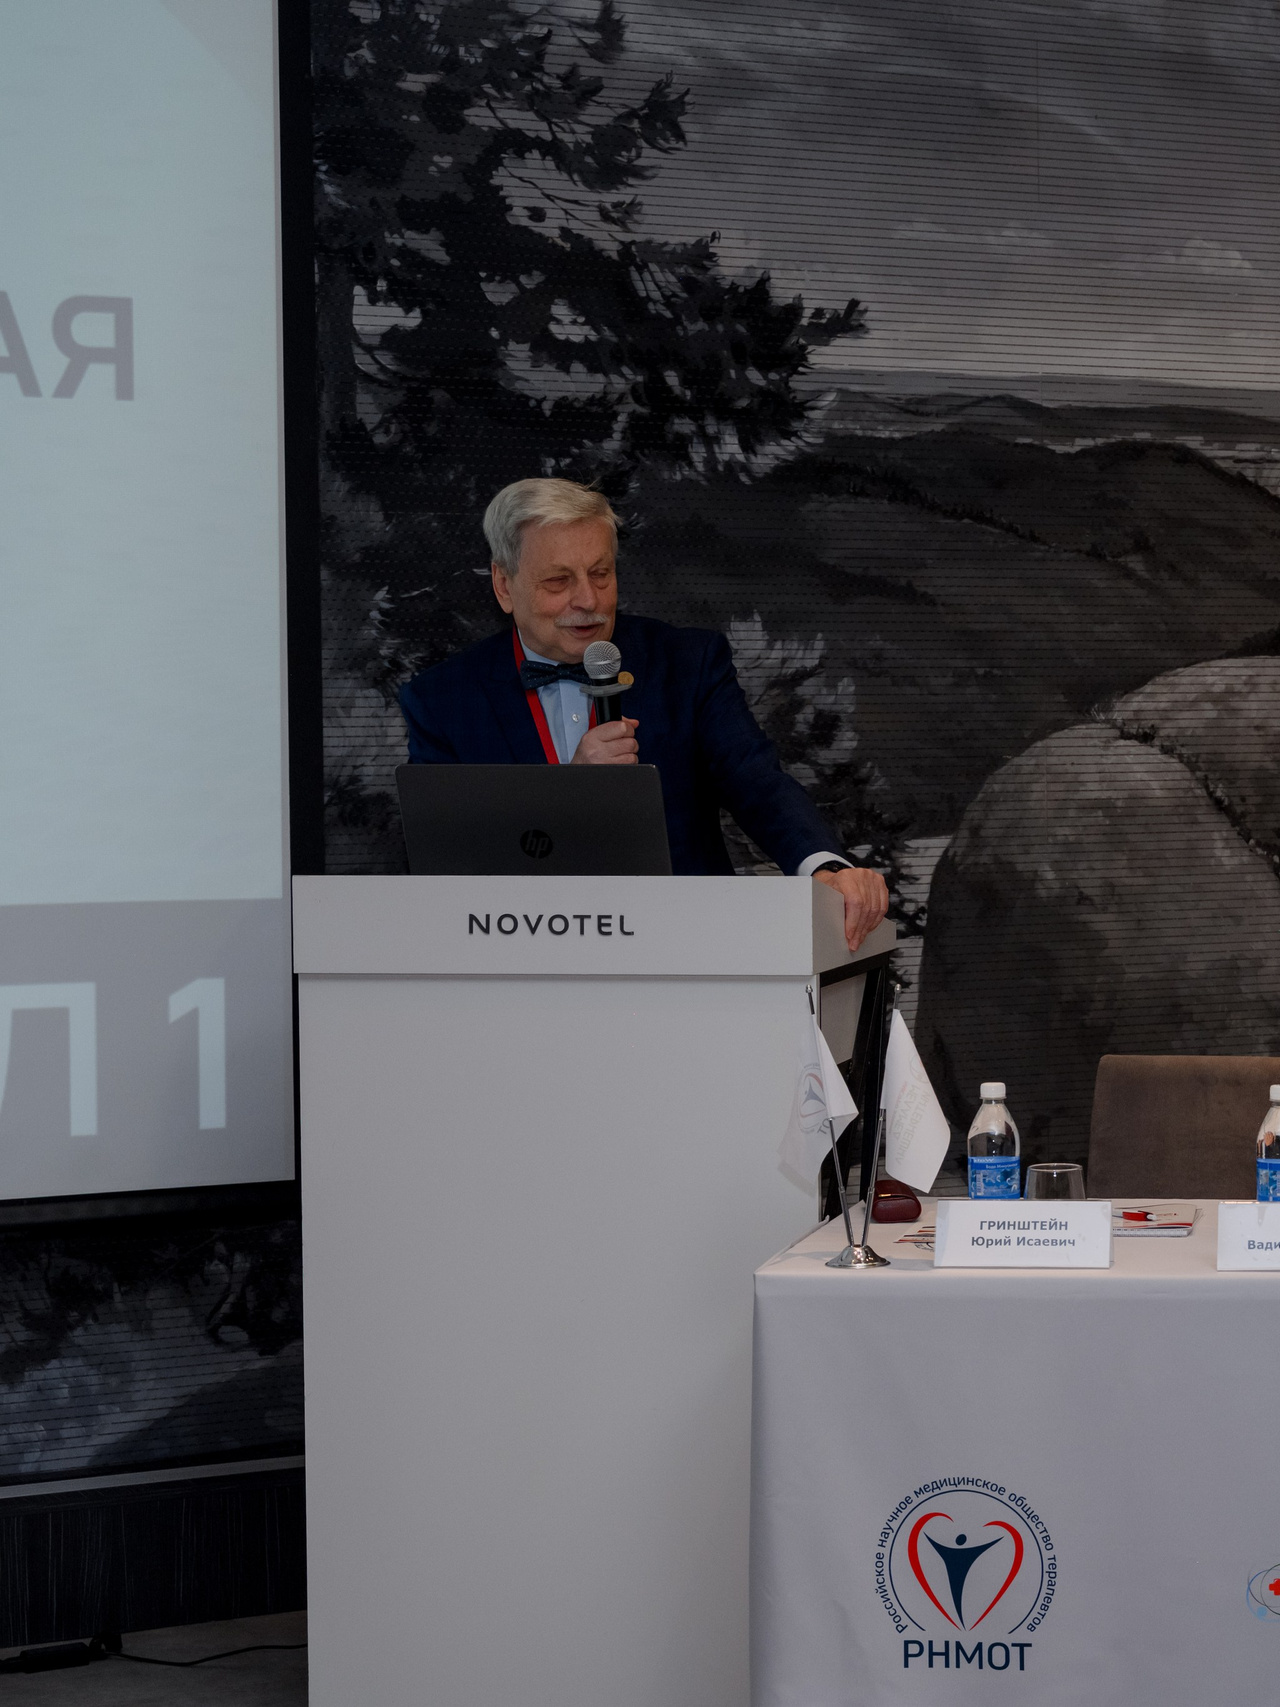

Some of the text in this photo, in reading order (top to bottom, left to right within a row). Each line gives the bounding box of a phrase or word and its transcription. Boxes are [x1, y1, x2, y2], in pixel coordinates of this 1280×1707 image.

[525, 829, 550, 859] hp
[468, 913, 635, 937] NOVOTEL
[168, 977, 226, 1130] 1
[979, 1218, 1068, 1231] ГРИНШТЕЙН
[971, 1234, 1076, 1249] Юрий Исаевич
[874, 1476, 1058, 1634] Российское научное медицинское общество терапевтов
[903, 1639, 1033, 1671] РНМОТ
